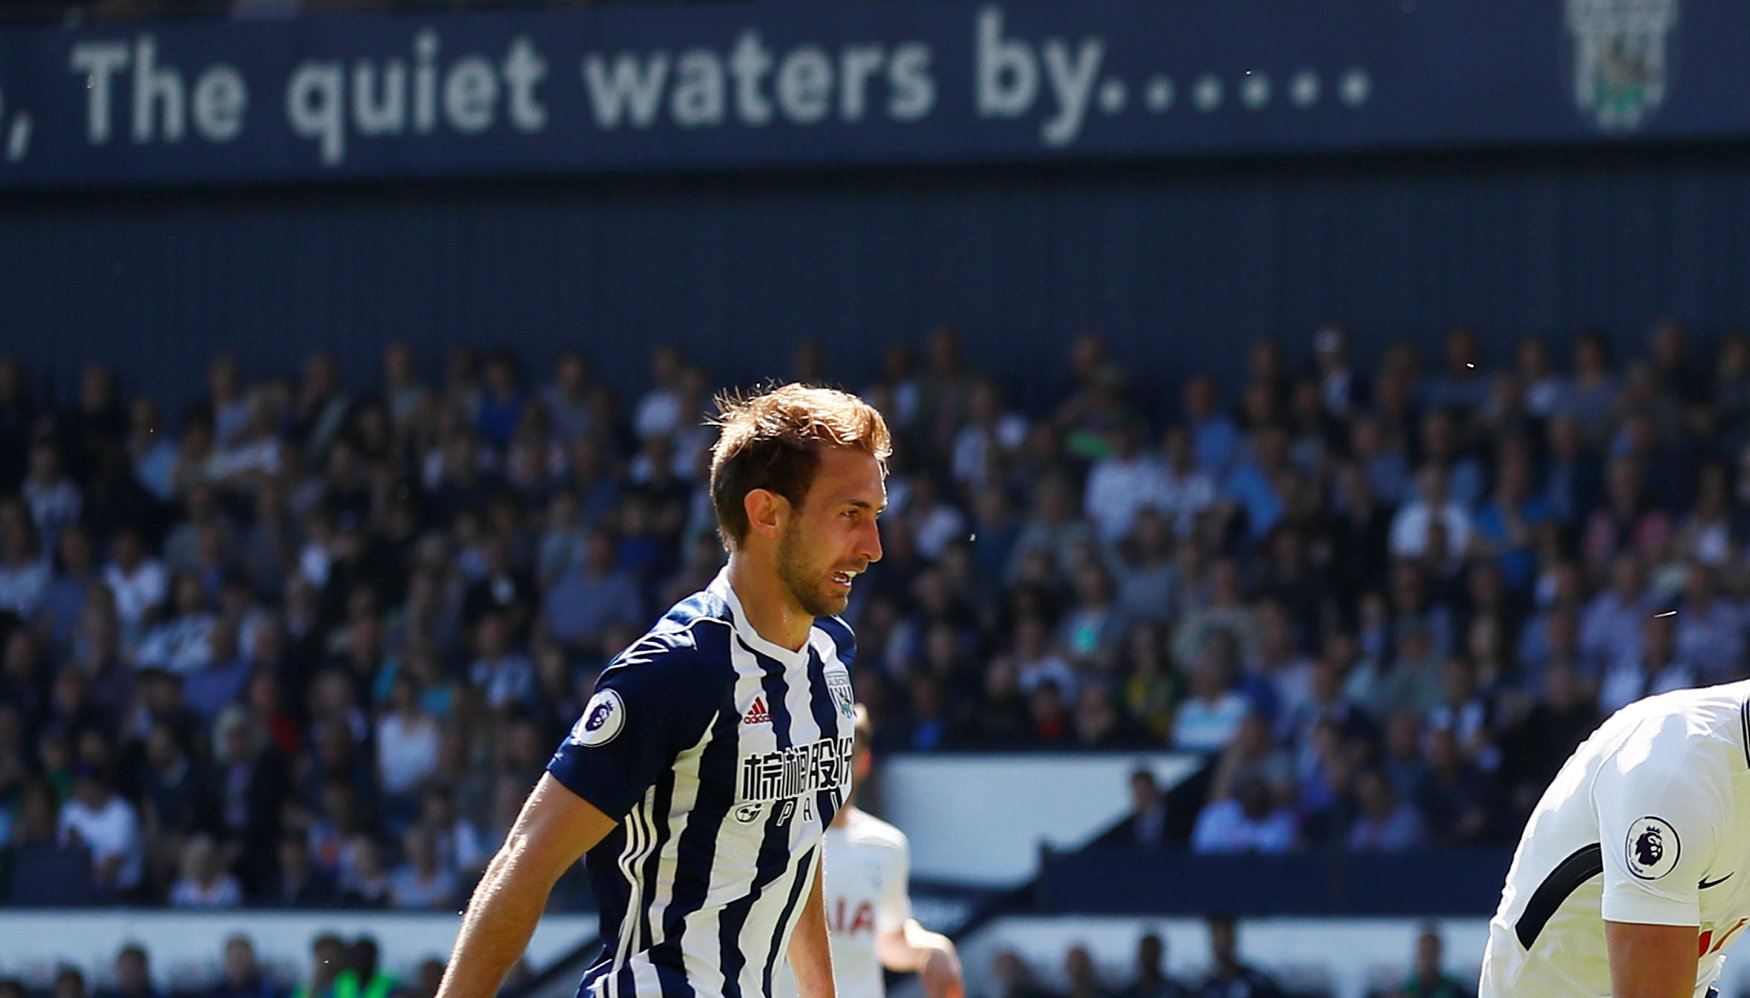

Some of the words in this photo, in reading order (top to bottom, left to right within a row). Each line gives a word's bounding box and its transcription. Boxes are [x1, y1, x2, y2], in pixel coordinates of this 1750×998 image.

[69, 37, 249, 143] The
[287, 28, 546, 164] quiet
[583, 32, 935, 126] waters
[826, 897, 876, 936] IA
